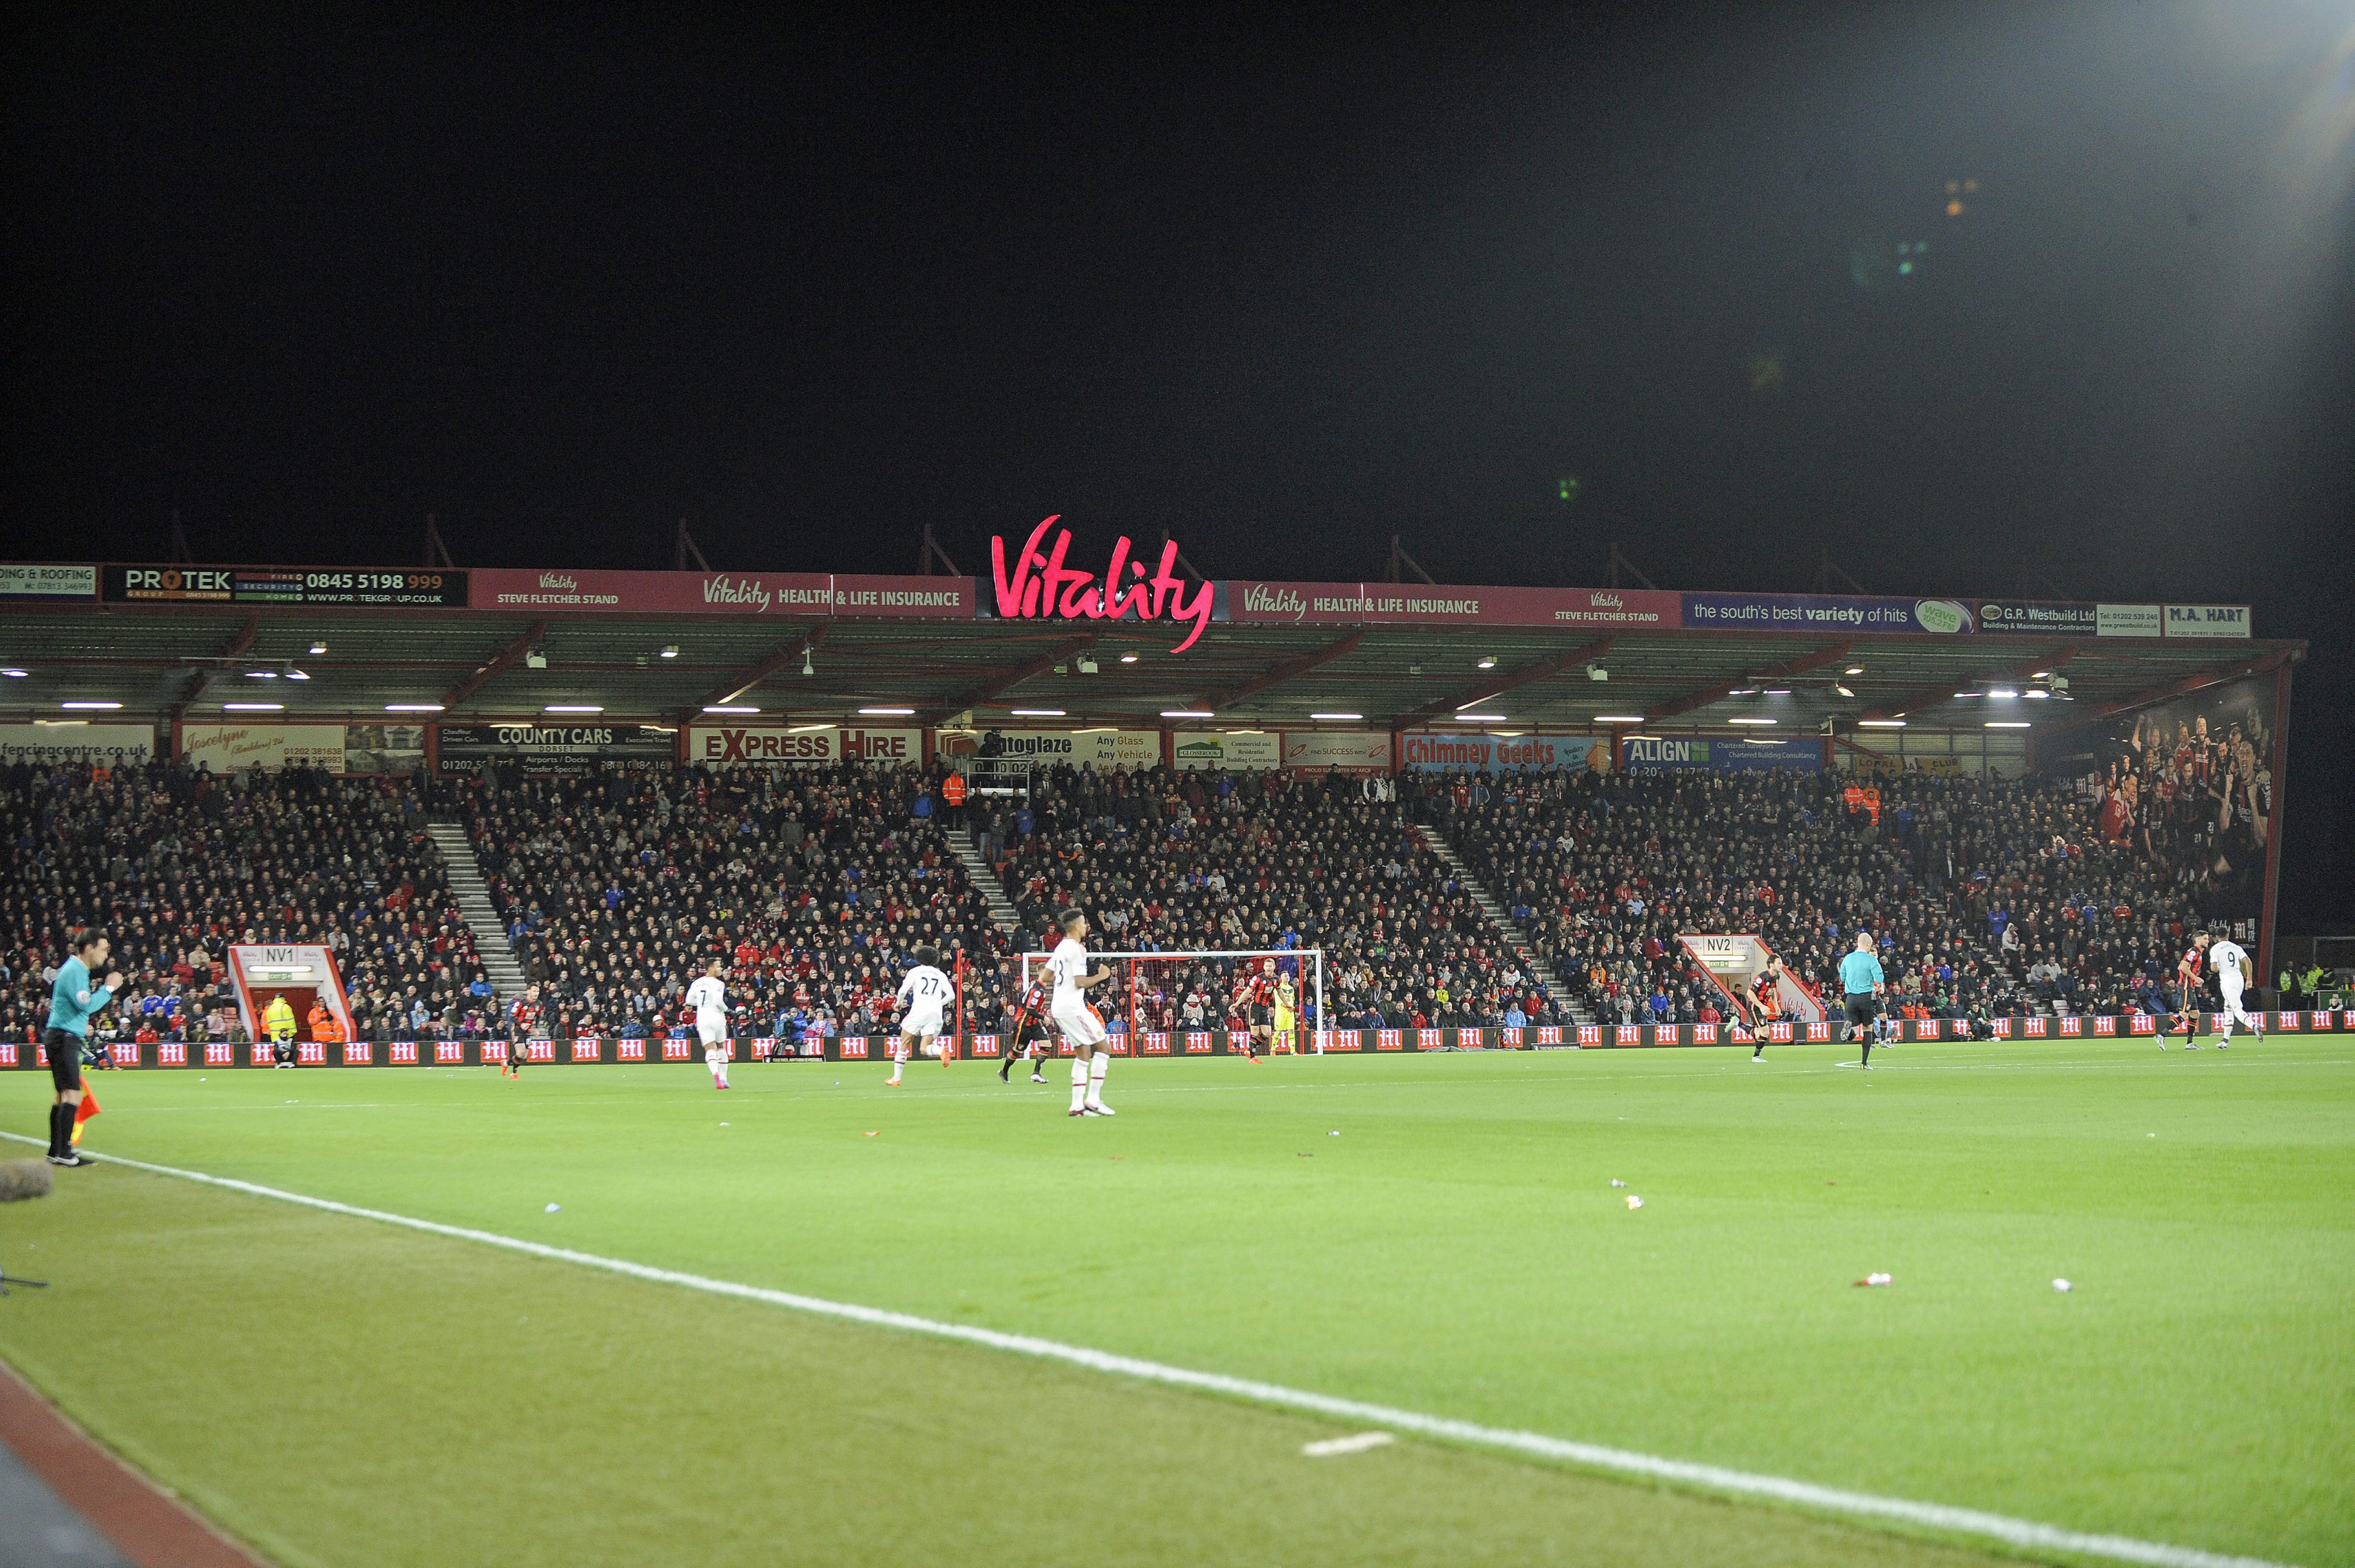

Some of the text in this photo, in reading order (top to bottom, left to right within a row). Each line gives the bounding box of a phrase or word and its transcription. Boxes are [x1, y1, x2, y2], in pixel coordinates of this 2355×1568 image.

[29, 570, 37, 579] &
[42, 570, 92, 580] ROOFING
[126, 570, 231, 590] PROTEK
[307, 573, 443, 589] 0845 5198 999
[539, 572, 577, 593] Vitality
[991, 514, 1214, 654] Vitality
[307, 593, 443, 603] WWW.PROTEKGROUP.CO.UK
[498, 594, 619, 604] STEVE FLETCHER STAND
[704, 574, 960, 613] Vitality HEALTH & LIFE INSURANCE
[1590, 591, 1623, 611] Vitality
[1244, 584, 1479, 621] Vitality HEALTH & LIFE INSURANCE
[1555, 611, 1659, 622] STEVE FLETCHER STAND
[1694, 604, 1908, 625] the south's best variety of hits
[1924, 604, 1957, 623] wave
[2004, 608, 2096, 622] G.R. Westbuild Ltd
[2170, 607, 2243, 622] M.A. HART
[1923, 614, 1955, 631] 105.2 FM
[1983, 622, 2009, 630] Building
[2017, 623, 2057, 631] Maintenance
[2058, 623, 2096, 632] Contractors
[499, 728, 613, 744] COUNTY CARS
[1096, 736, 1144, 747] Any Glass
[2, 743, 148, 758] fencingcentre.co.uk
[706, 730, 906, 762] EXPRESS HIRE
[1001, 736, 1072, 755] utoglaze
[1406, 738, 1555, 764] Chimney Geeks
[1631, 741, 1689, 762] ALIGN
[526, 756, 558, 764] Airports
[1096, 750, 1153, 761] Any Vehicle
[1758, 752, 1781, 760] Building
[1782, 752, 1817, 760] Consultancy
[442, 760, 473, 770] 01202
[1708, 938, 1731, 951] NV2
[267, 948, 293, 963] NV1
[2228, 952, 2235, 967] 9
[921, 976, 939, 995] 27
[700, 990, 707, 1006] 7
